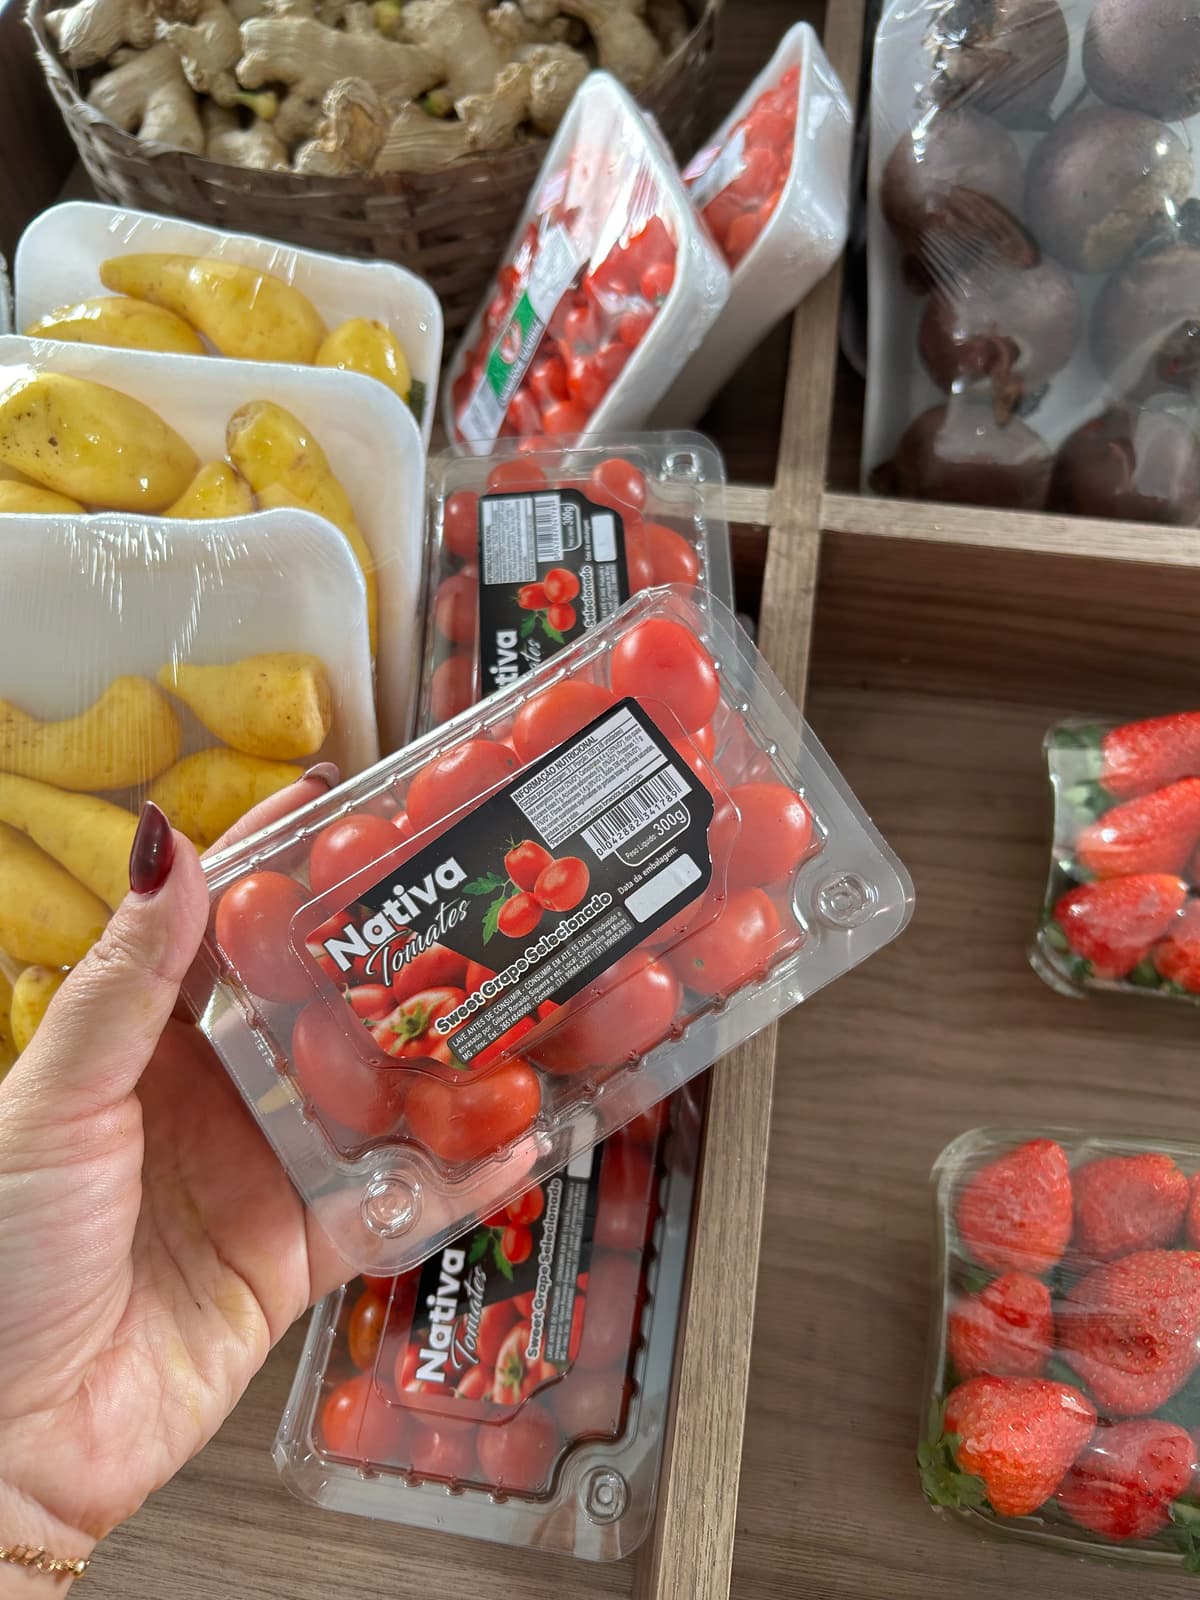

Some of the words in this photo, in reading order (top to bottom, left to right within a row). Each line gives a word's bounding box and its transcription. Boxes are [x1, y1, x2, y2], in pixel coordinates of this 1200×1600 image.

[579, 564, 596, 628] Selecionado
[488, 630, 518, 688] tiva
[512, 764, 557, 803] INFORMAÇÃO
[553, 733, 598, 770] NUTRICIONAL
[603, 818, 642, 849] 042882
[640, 788, 680, 821] 341789
[650, 805, 688, 839] 300g
[616, 879, 634, 895] Data
[631, 870, 643, 883] da
[640, 844, 680, 877] embalagem:
[323, 856, 468, 973] Nativa
[365, 897, 471, 986] Tomates
[435, 992, 486, 1036] Sweet
[480, 956, 530, 999] Grape
[523, 891, 614, 965] Selecionado
[450, 1031, 468, 1047] LAVE
[464, 1016, 486, 1036] ANTES
[483, 1010, 494, 1021] DE
[491, 988, 523, 1014] CONSUMIR
[455, 1030, 483, 1054] envasado
[491, 1009, 510, 1026] Gilson
[460, 1048, 473, 1060] MG
[537, 1177, 563, 1265] Selecionado
[415, 1248, 467, 1382] Nativa
[451, 1265, 487, 1369] Tomates
[533, 1264, 552, 1312] Grape
[525, 1311, 544, 1360] Sweet
